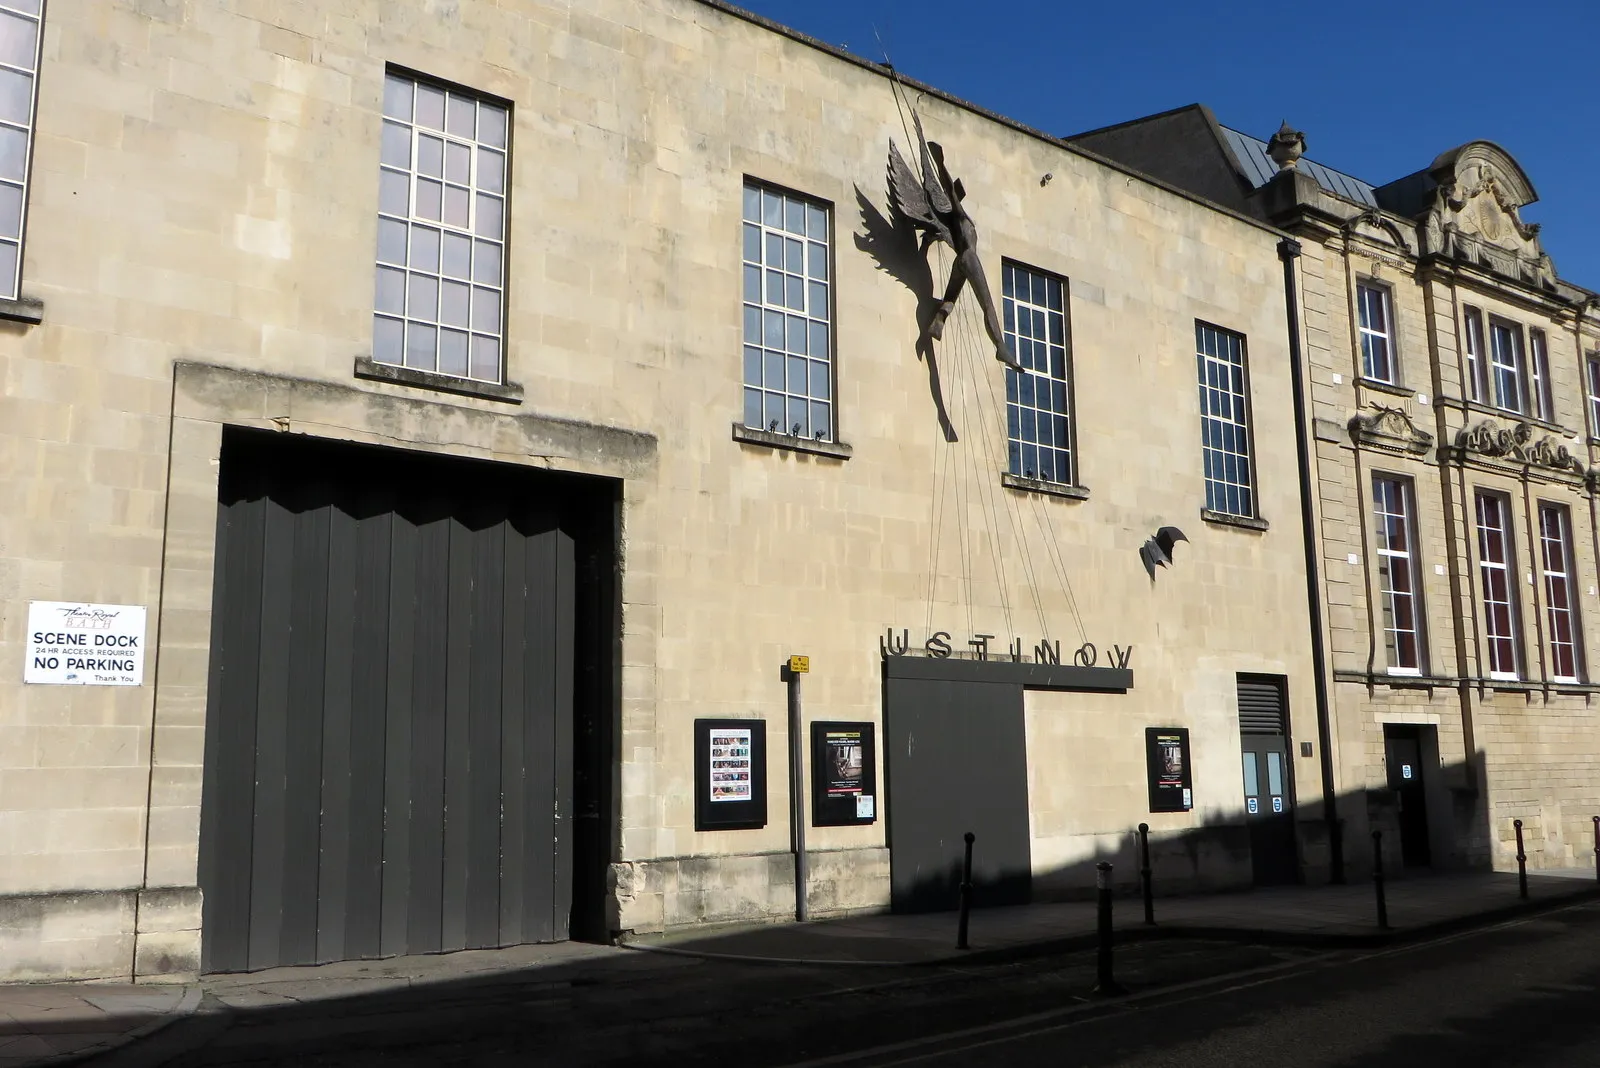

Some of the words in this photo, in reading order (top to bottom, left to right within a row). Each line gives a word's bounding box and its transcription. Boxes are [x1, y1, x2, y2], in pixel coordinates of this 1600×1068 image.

[66, 618, 112, 629] BATH
[33, 632, 87, 646] SCENE
[94, 634, 139, 647] DOCK
[97, 649, 135, 657] REQUIRED
[887, 627, 1132, 669] USTINOV
[34, 657, 59, 669] NO
[66, 658, 134, 672] PARKING
